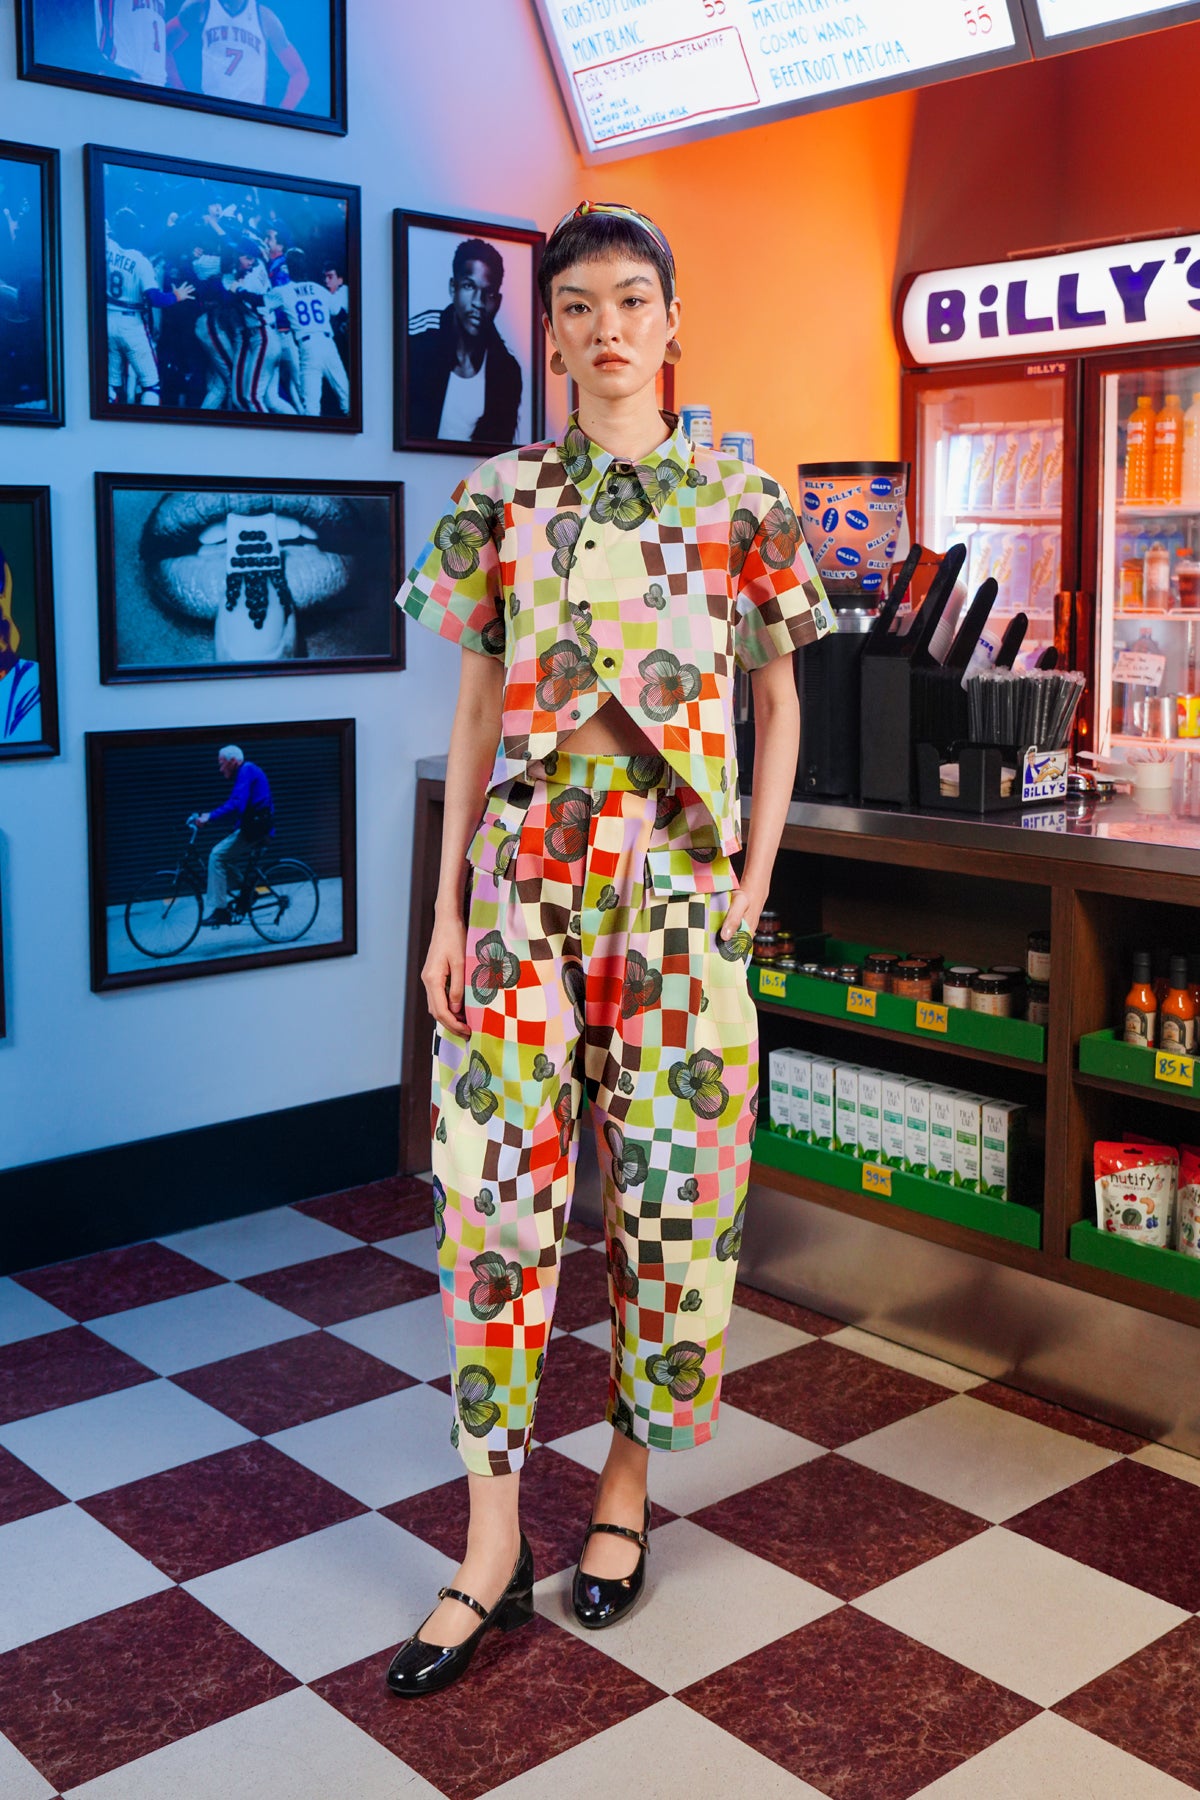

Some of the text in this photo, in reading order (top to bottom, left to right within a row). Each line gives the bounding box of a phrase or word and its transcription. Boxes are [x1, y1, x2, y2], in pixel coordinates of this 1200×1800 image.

[751, 0, 808, 30] MATCHA
[963, 5, 993, 36] 55
[206, 26, 262, 54] NEW YORK
[571, 20, 645, 64] MONT BLANC
[759, 14, 868, 55] COSMO WANDA
[224, 48, 244, 76] 7
[651, 50, 668, 63] FOR
[769, 39, 911, 89] BEETROOT MATCHA
[110, 270, 123, 298] 8
[295, 299, 325, 325] 86
[849, 990, 873, 1009] 59K
[919, 1007, 945, 1026] 49K
[865, 1169, 889, 1187] 99K
[1110, 1172, 1156, 1190] nutify
